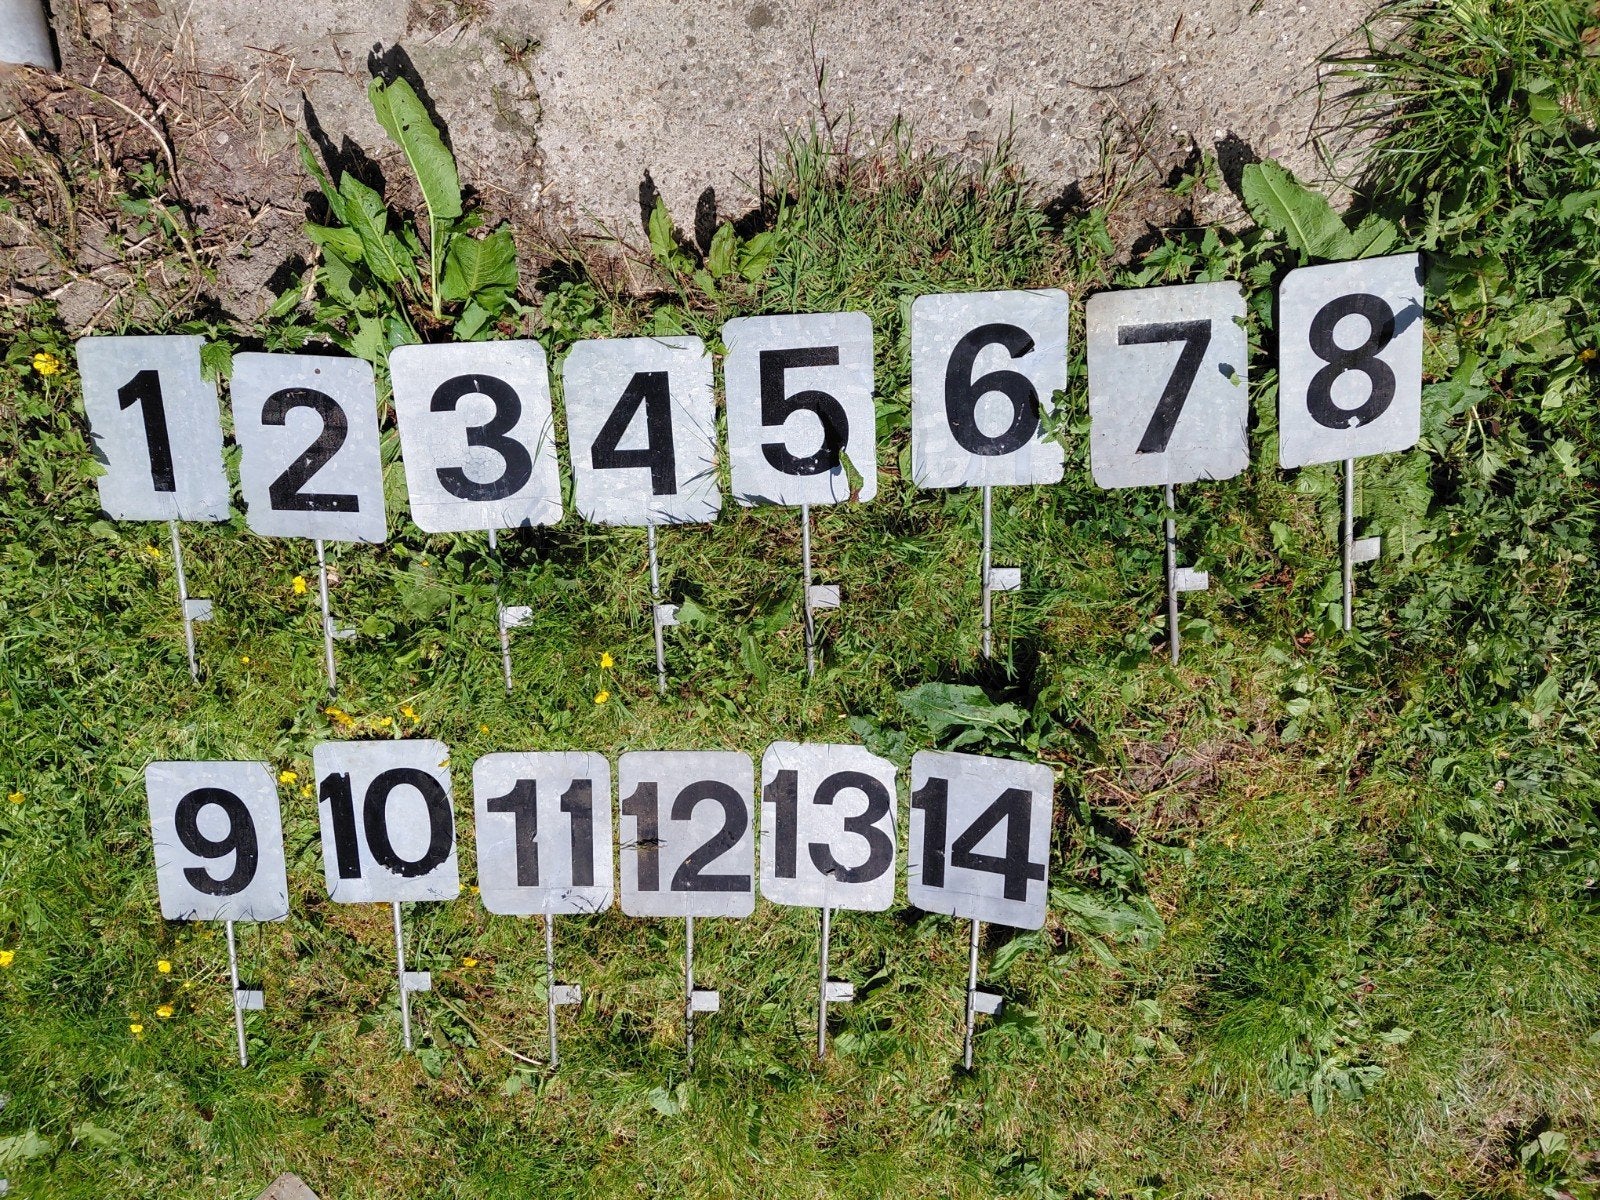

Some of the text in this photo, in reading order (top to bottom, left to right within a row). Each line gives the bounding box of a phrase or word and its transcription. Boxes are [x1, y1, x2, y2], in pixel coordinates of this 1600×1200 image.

[759, 345, 850, 476] 5
[944, 323, 1040, 456] 6
[1117, 319, 1212, 454] 7
[1306, 293, 1396, 430] 8
[117, 369, 177, 493] 1
[261, 387, 360, 513] 2
[430, 373, 533, 502] 3
[590, 370, 677, 496] 4
[174, 787, 259, 897] 9
[318, 767, 454, 880] 10
[486, 778, 595, 887] 11
[621, 779, 751, 892] 12
[762, 769, 894, 883] 13
[911, 776, 1046, 902] 14
